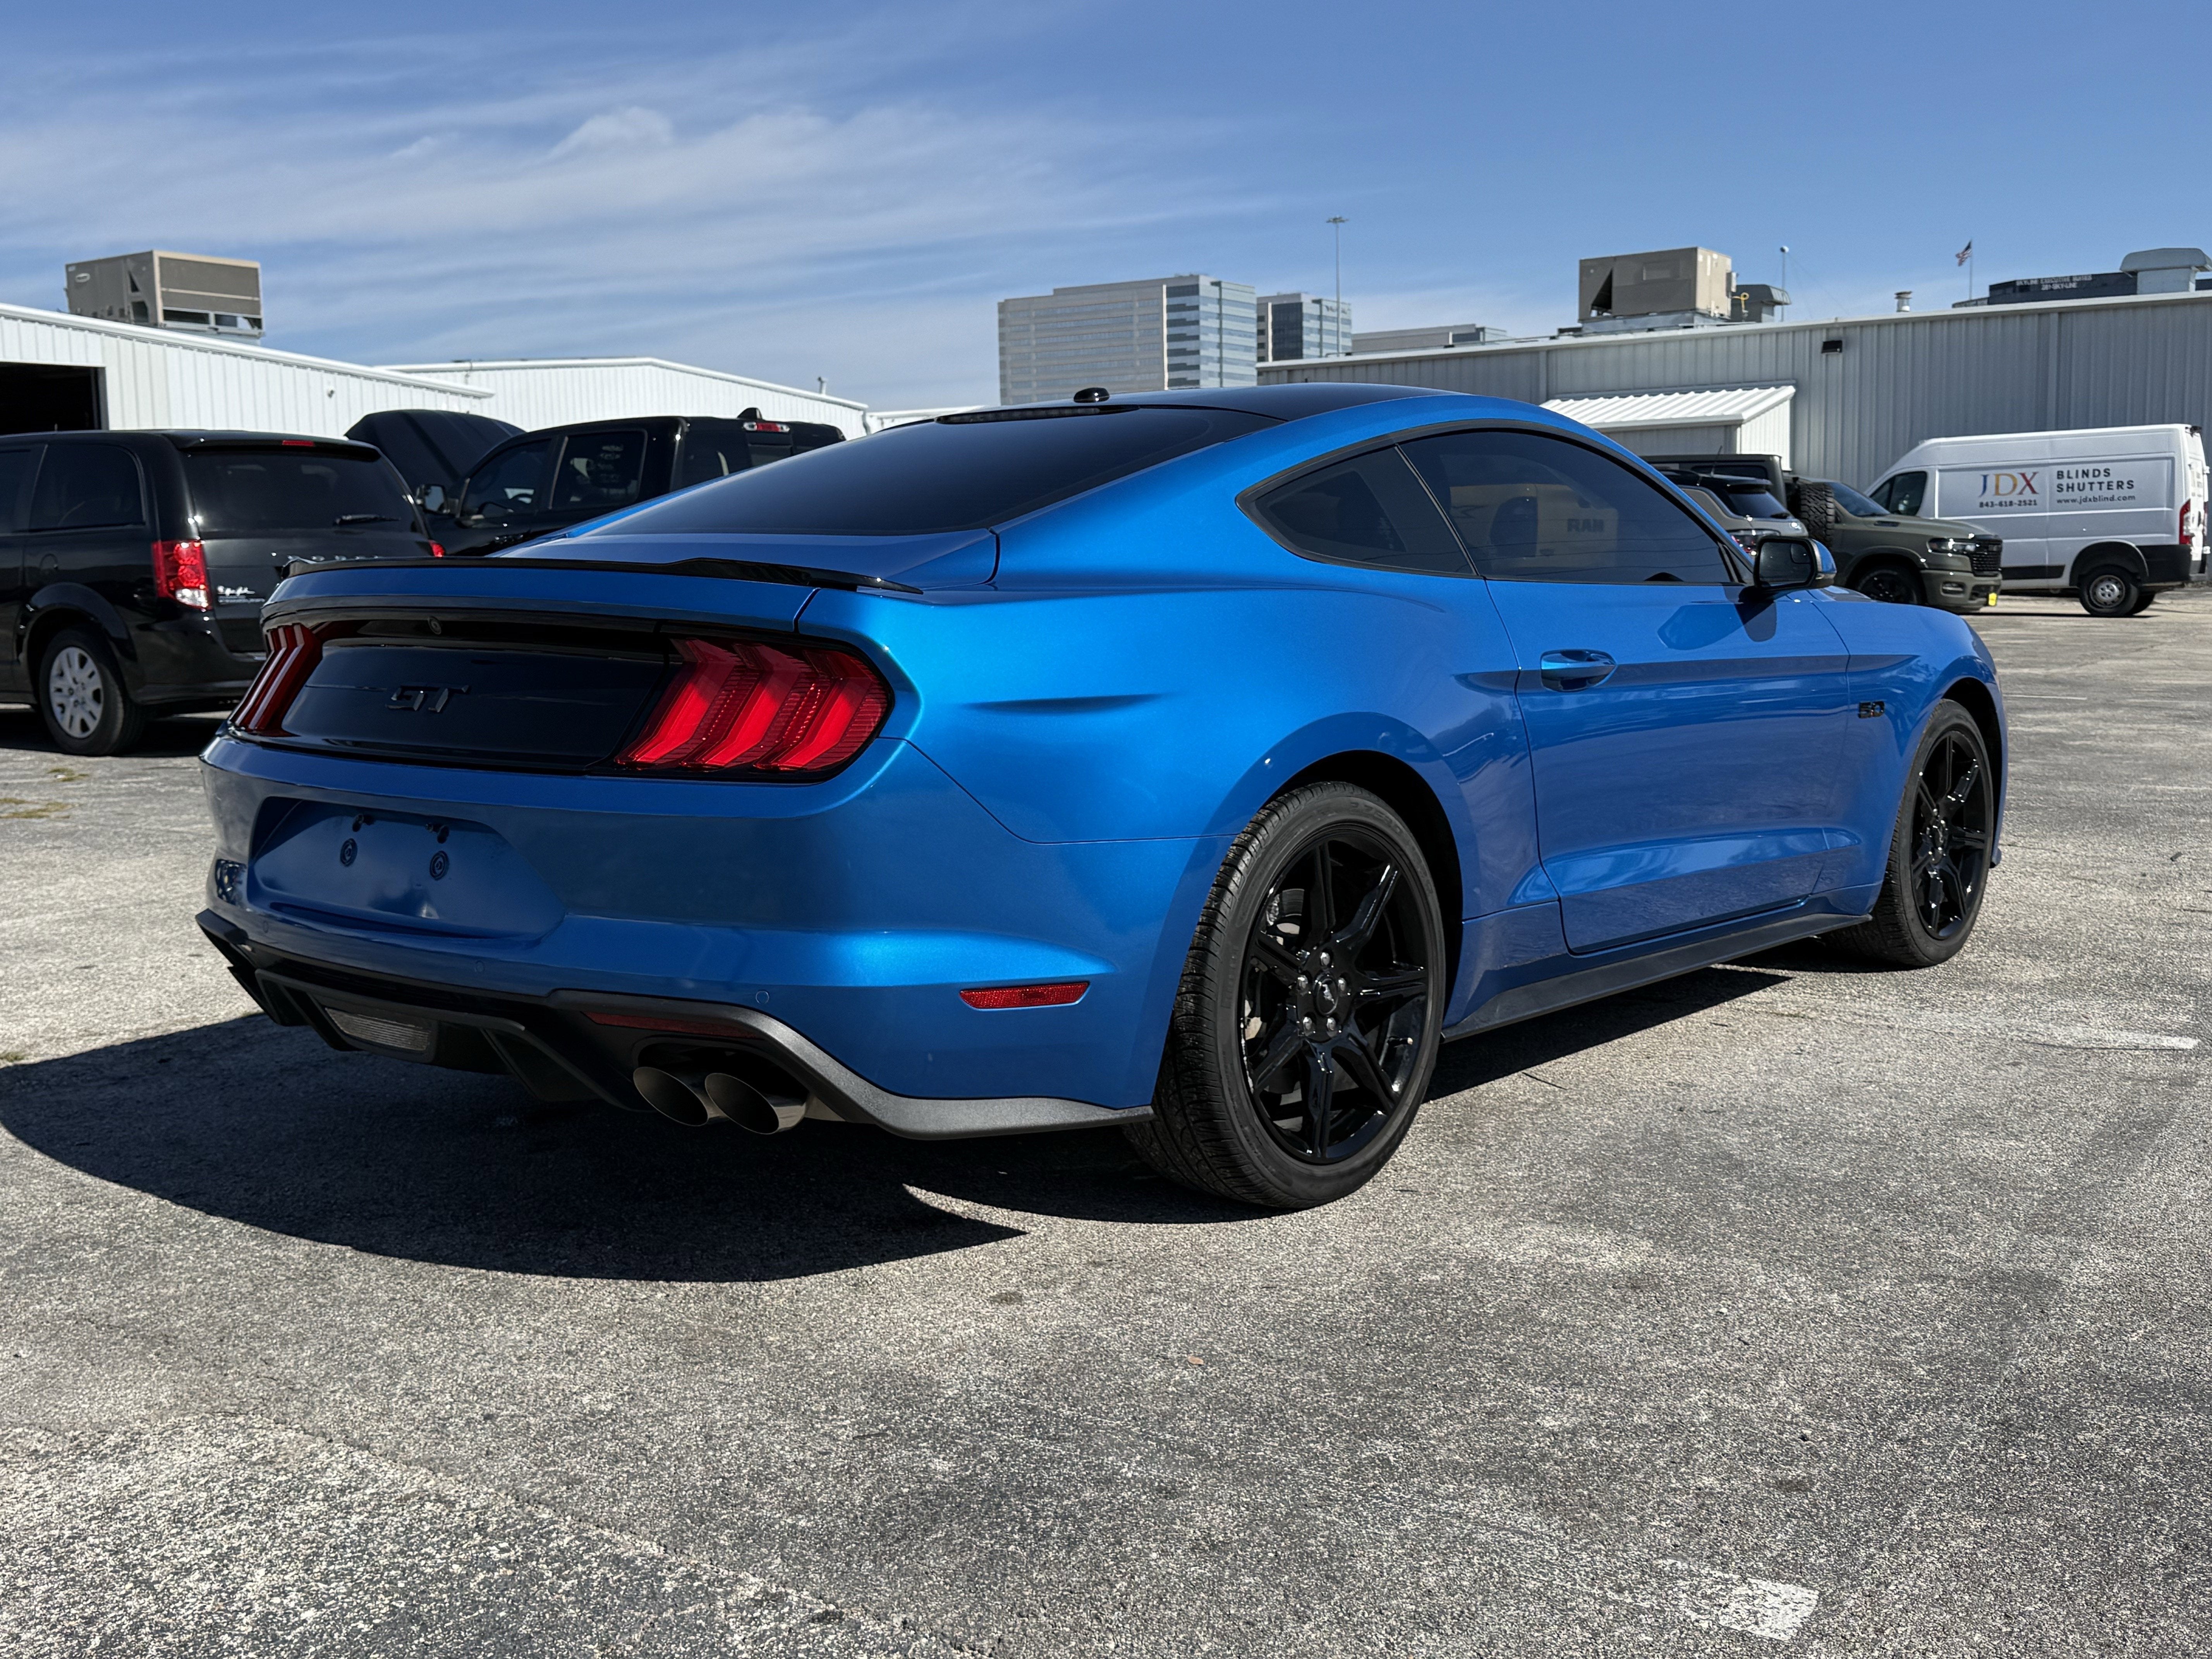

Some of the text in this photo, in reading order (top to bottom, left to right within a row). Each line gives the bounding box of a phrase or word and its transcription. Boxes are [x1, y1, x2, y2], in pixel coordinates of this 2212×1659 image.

[2056, 468, 2111, 479] BLINDS
[1978, 471, 2039, 497] JDX
[2056, 480, 2135, 493] SHUTTERS
[2057, 495, 2136, 505] www.jdxblind.com
[385, 682, 470, 713] GT
